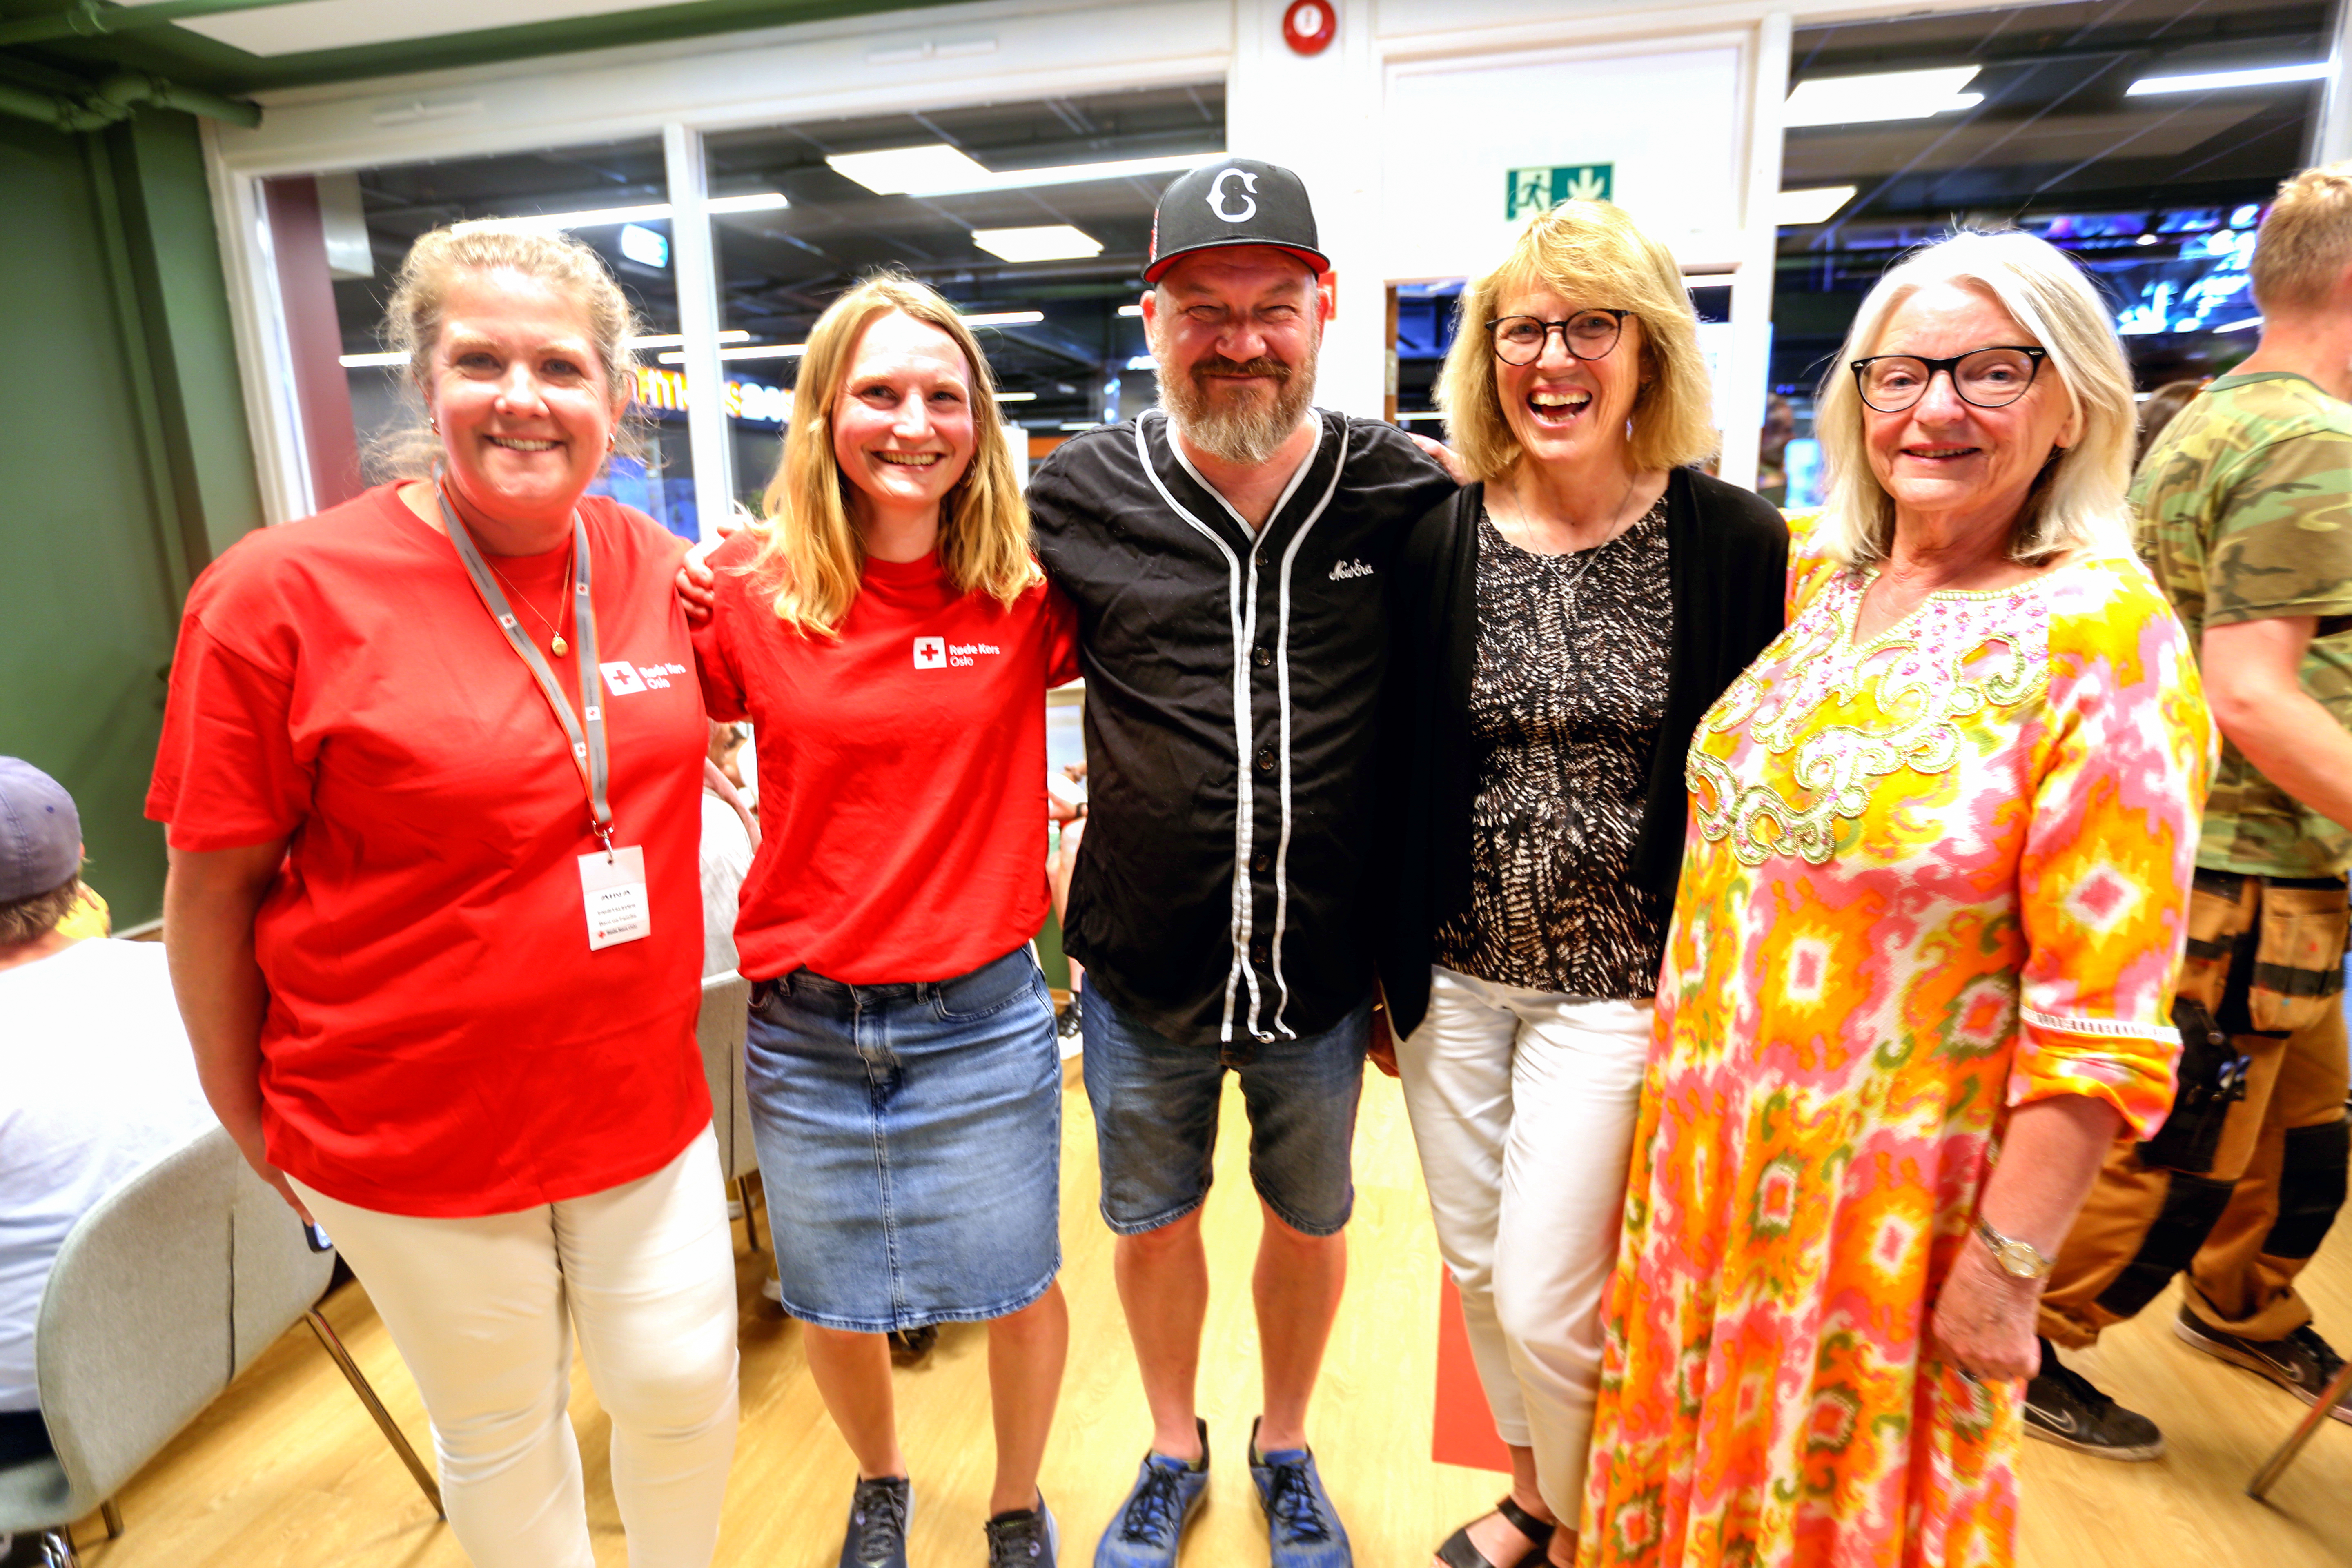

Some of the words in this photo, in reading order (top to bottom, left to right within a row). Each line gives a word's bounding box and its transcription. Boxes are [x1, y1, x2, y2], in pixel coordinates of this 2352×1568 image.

[949, 643, 978, 655] Røde
[978, 643, 1000, 655] Kors
[950, 655, 974, 667] Oslo
[647, 676, 670, 689] Oslo
